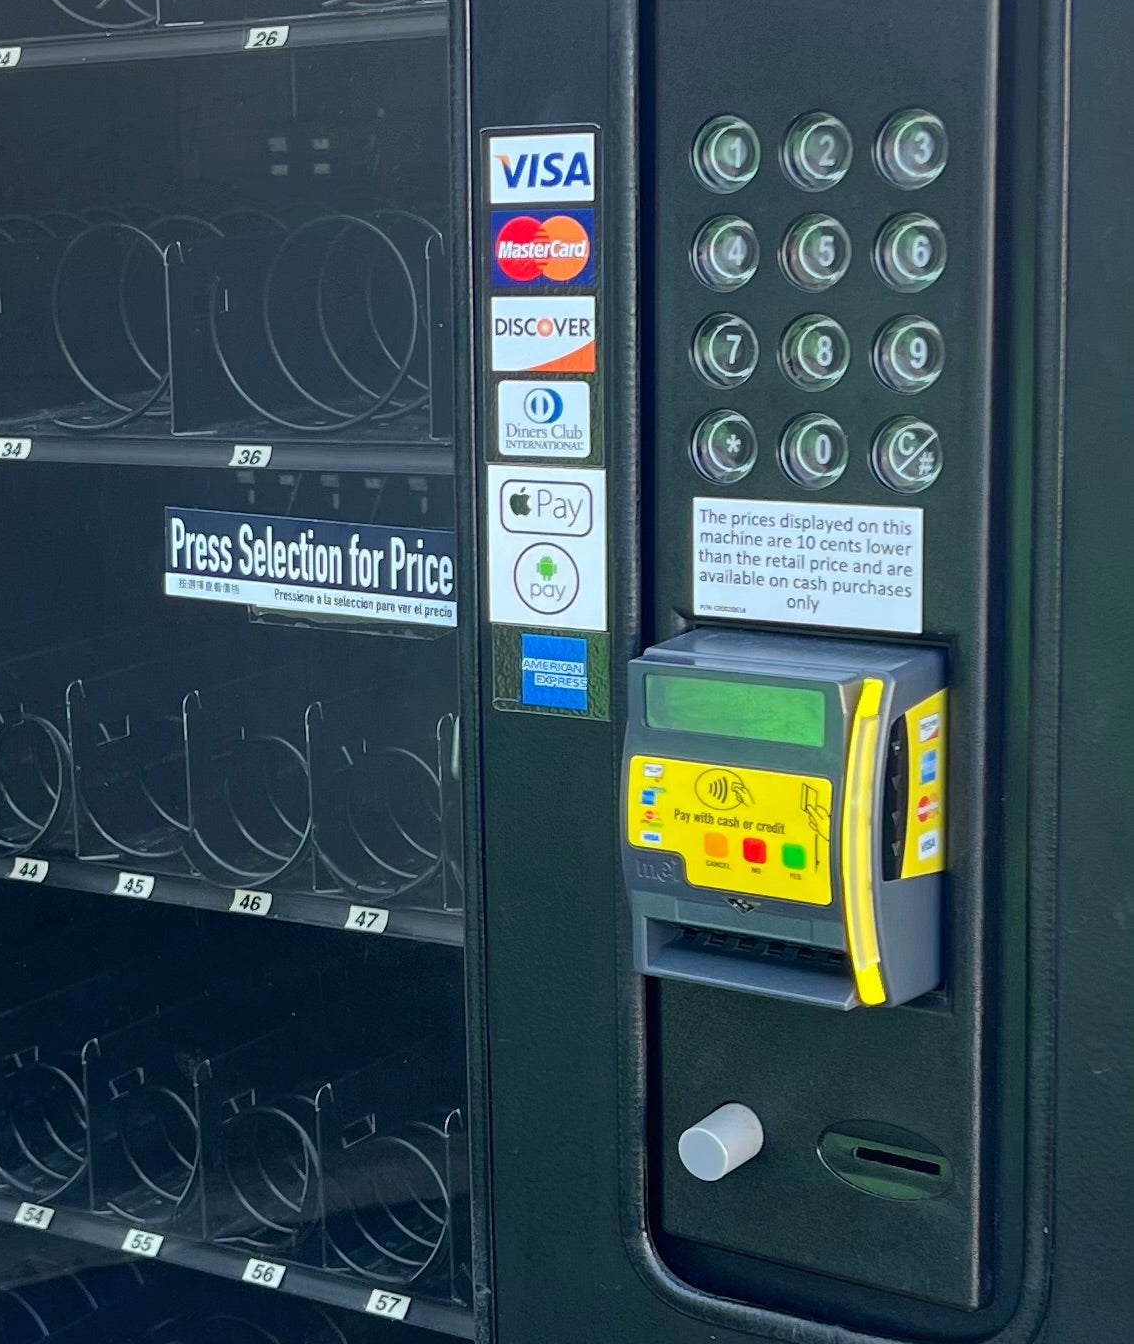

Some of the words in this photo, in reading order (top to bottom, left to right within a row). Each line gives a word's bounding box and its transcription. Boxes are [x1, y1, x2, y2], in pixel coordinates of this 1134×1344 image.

[257, 29, 278, 46] 26
[730, 137, 743, 169] 1
[818, 135, 835, 167] 2
[913, 130, 932, 165] 3
[496, 152, 591, 188] VISA
[498, 239, 587, 259] MasterCard
[728, 235, 745, 266] 4
[817, 235, 834, 267] 5
[911, 235, 929, 268] 6
[495, 317, 590, 338] DISCOVER
[726, 335, 742, 364] 7
[816, 335, 833, 367] 8
[909, 337, 928, 369] 9
[506, 423, 548, 439] Diners
[551, 423, 583, 440] Club
[1, 444, 20, 457] 34
[505, 440, 583, 451] INTERNATIONAL
[814, 433, 831, 465] 0
[237, 450, 261, 465] 36
[537, 489, 583, 527] Pay
[699, 508, 727, 525] The
[731, 512, 776, 529] prices
[780, 513, 853, 534] displayed
[858, 522, 878, 534] on
[883, 519, 912, 536] this
[700, 530, 763, 546] machine
[767, 537, 793, 549] are
[796, 535, 816, 550] 10
[820, 538, 862, 553] cents
[866, 539, 912, 556] lower
[170, 517, 233, 574] Press
[238, 523, 343, 585] Selection
[348, 533, 384, 587] for
[390, 536, 454, 596] Price
[698, 549, 732, 565] than
[736, 551, 761, 567] the
[766, 554, 805, 570] retail
[810, 557, 848, 573] price
[853, 560, 882, 575] and
[887, 563, 913, 577] are
[530, 583, 566, 602] pay
[699, 569, 765, 587] available
[769, 575, 788, 589] on
[793, 575, 827, 592] cash
[832, 581, 912, 598] purchases
[324, 593, 332, 606] la
[333, 594, 374, 610] seleccion
[398, 604, 411, 614] ver
[414, 603, 423, 615] el
[424, 607, 453, 619] precio
[786, 595, 820, 614] only
[523, 659, 583, 674] AMERICAN
[536, 675, 587, 688] EXPRESS
[674, 808, 690, 824] Pay
[693, 811, 714, 825] with
[717, 814, 739, 828] cash
[742, 819, 753, 830] or
[756, 819, 786, 834] credit
[18, 863, 38, 878] 44
[706, 860, 730, 869] CANCEL
[123, 879, 144, 894] 45
[240, 895, 262, 910] 46
[355, 910, 380, 926] 47
[25, 1209, 43, 1223] 54
[131, 1234, 155, 1252] 55
[252, 1264, 274, 1282] 56
[375, 1295, 401, 1313] 57
